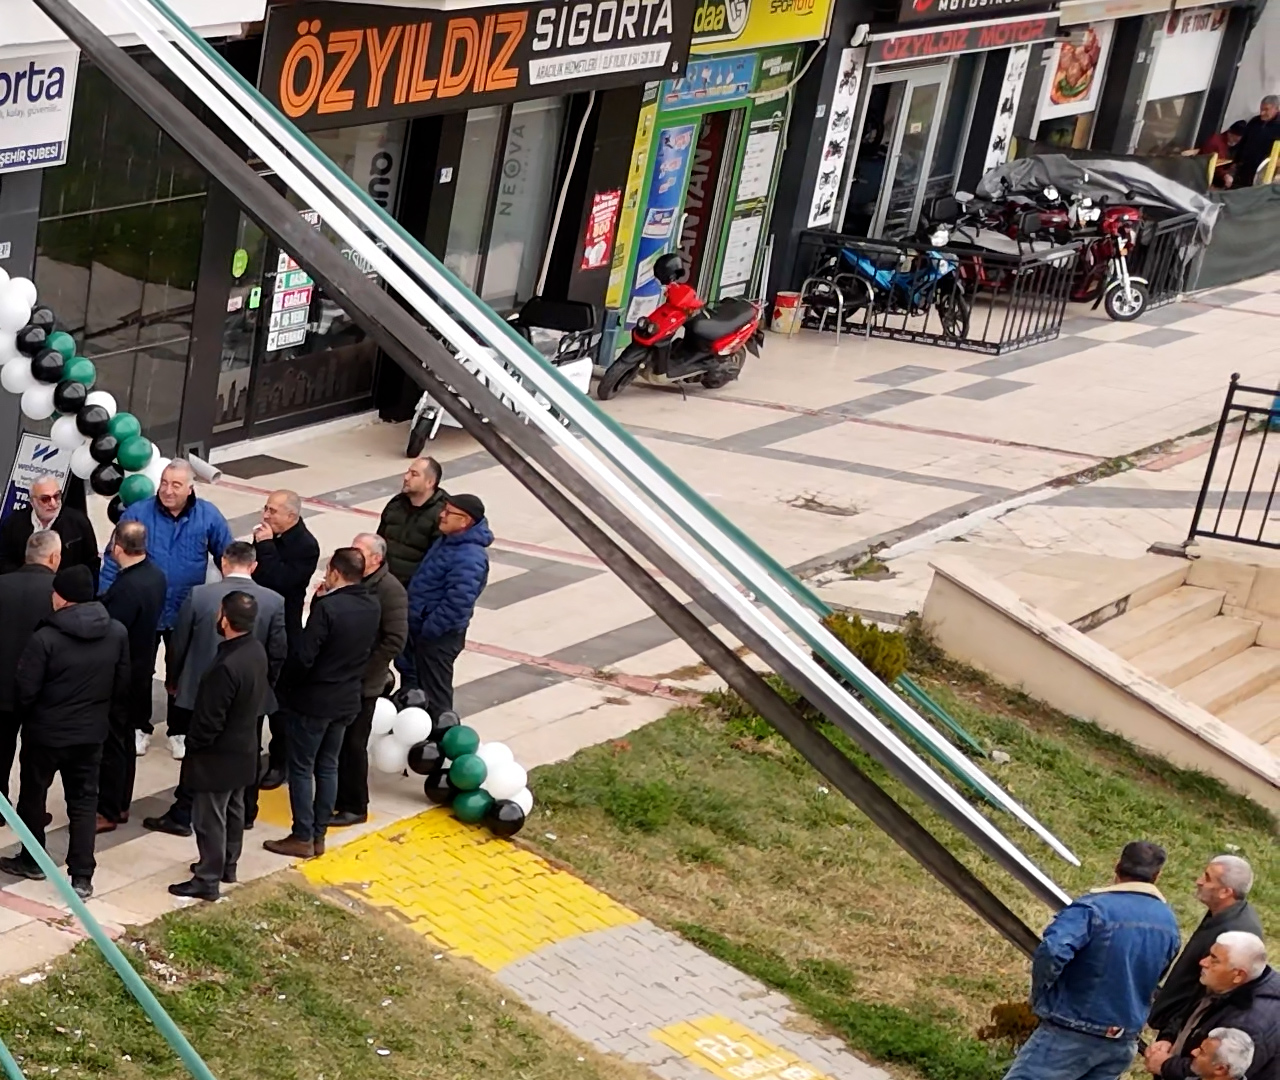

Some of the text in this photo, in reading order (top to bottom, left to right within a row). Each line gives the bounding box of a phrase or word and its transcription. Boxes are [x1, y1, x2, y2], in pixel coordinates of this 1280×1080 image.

[532, 0, 673, 52] SİGORTA
[977, 18, 1047, 48] MOTOR
[279, 10, 529, 118] ÖZYILDIZ
[26, 143, 59, 163] ŞUBESİ
